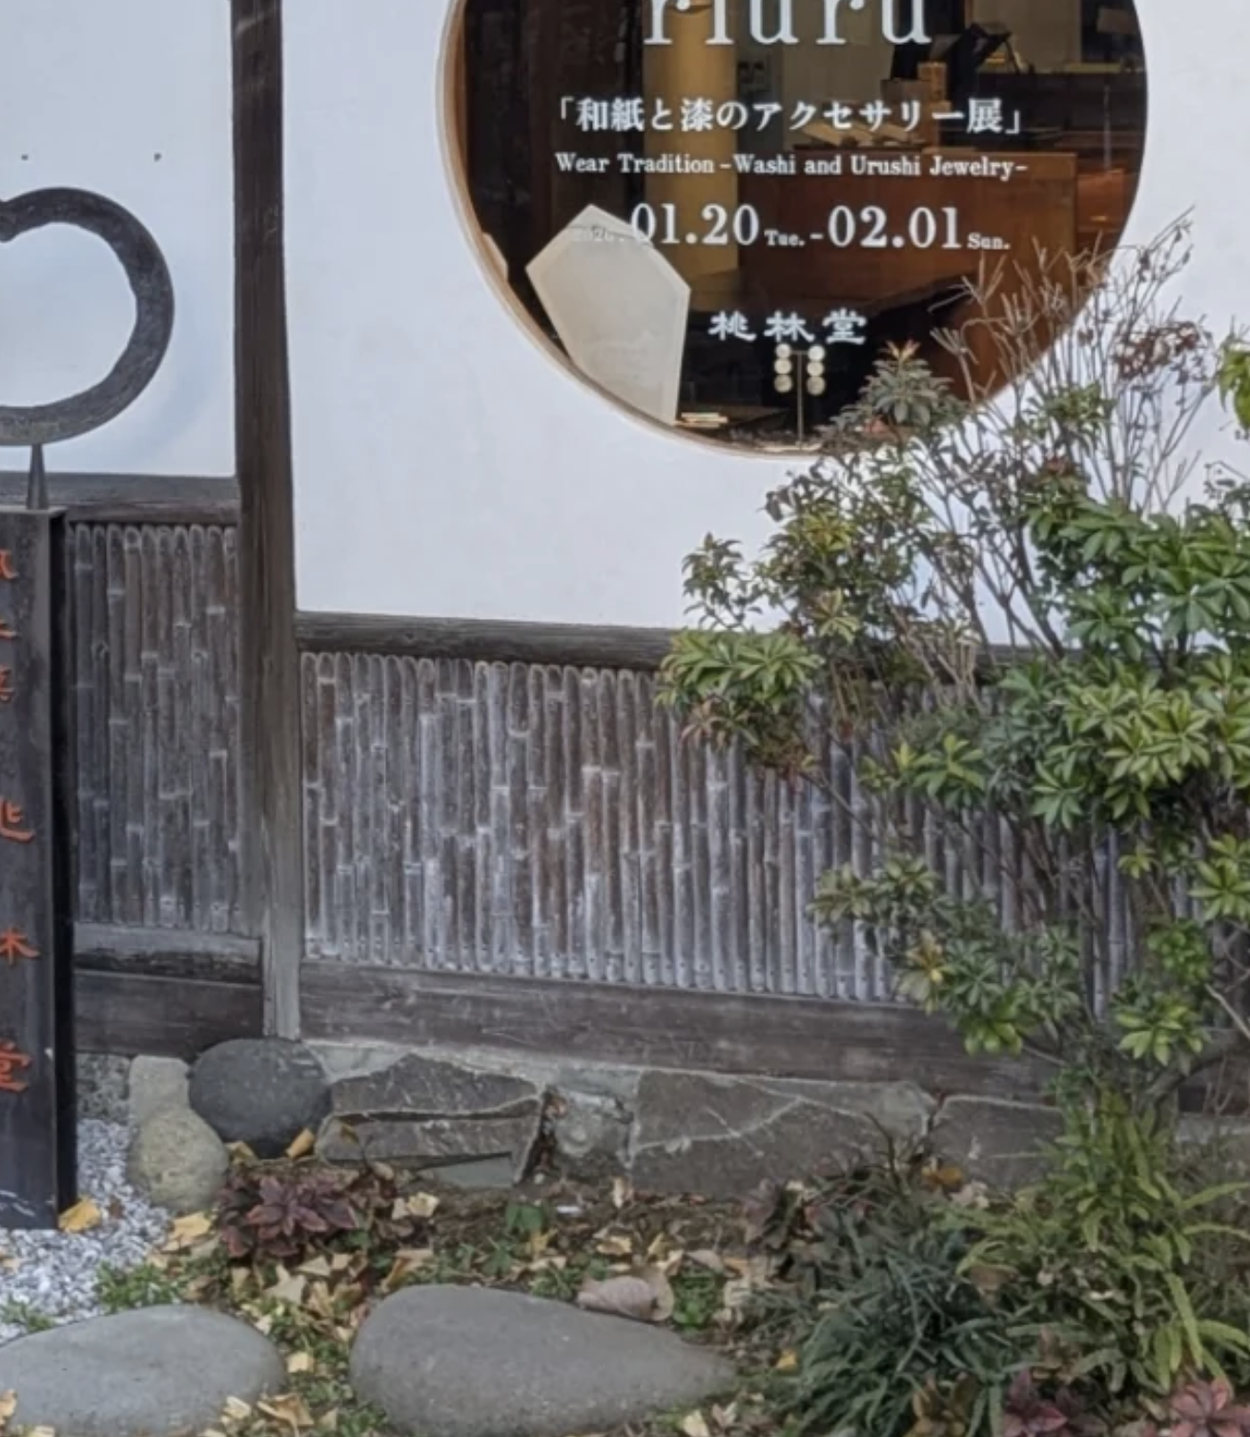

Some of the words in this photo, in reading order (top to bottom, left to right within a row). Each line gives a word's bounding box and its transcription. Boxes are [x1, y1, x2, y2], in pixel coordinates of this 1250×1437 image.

[559, 96, 1021, 134] 「和紙と漆のアクセサリー展」
[555, 152, 610, 173] Wear
[617, 153, 715, 174] Tradition
[804, 156, 842, 176] and
[850, 156, 921, 176] Urushi
[630, 203, 760, 246] 01.20
[967, 232, 1011, 250] Sun.
[708, 307, 867, 345] 桃林堂
